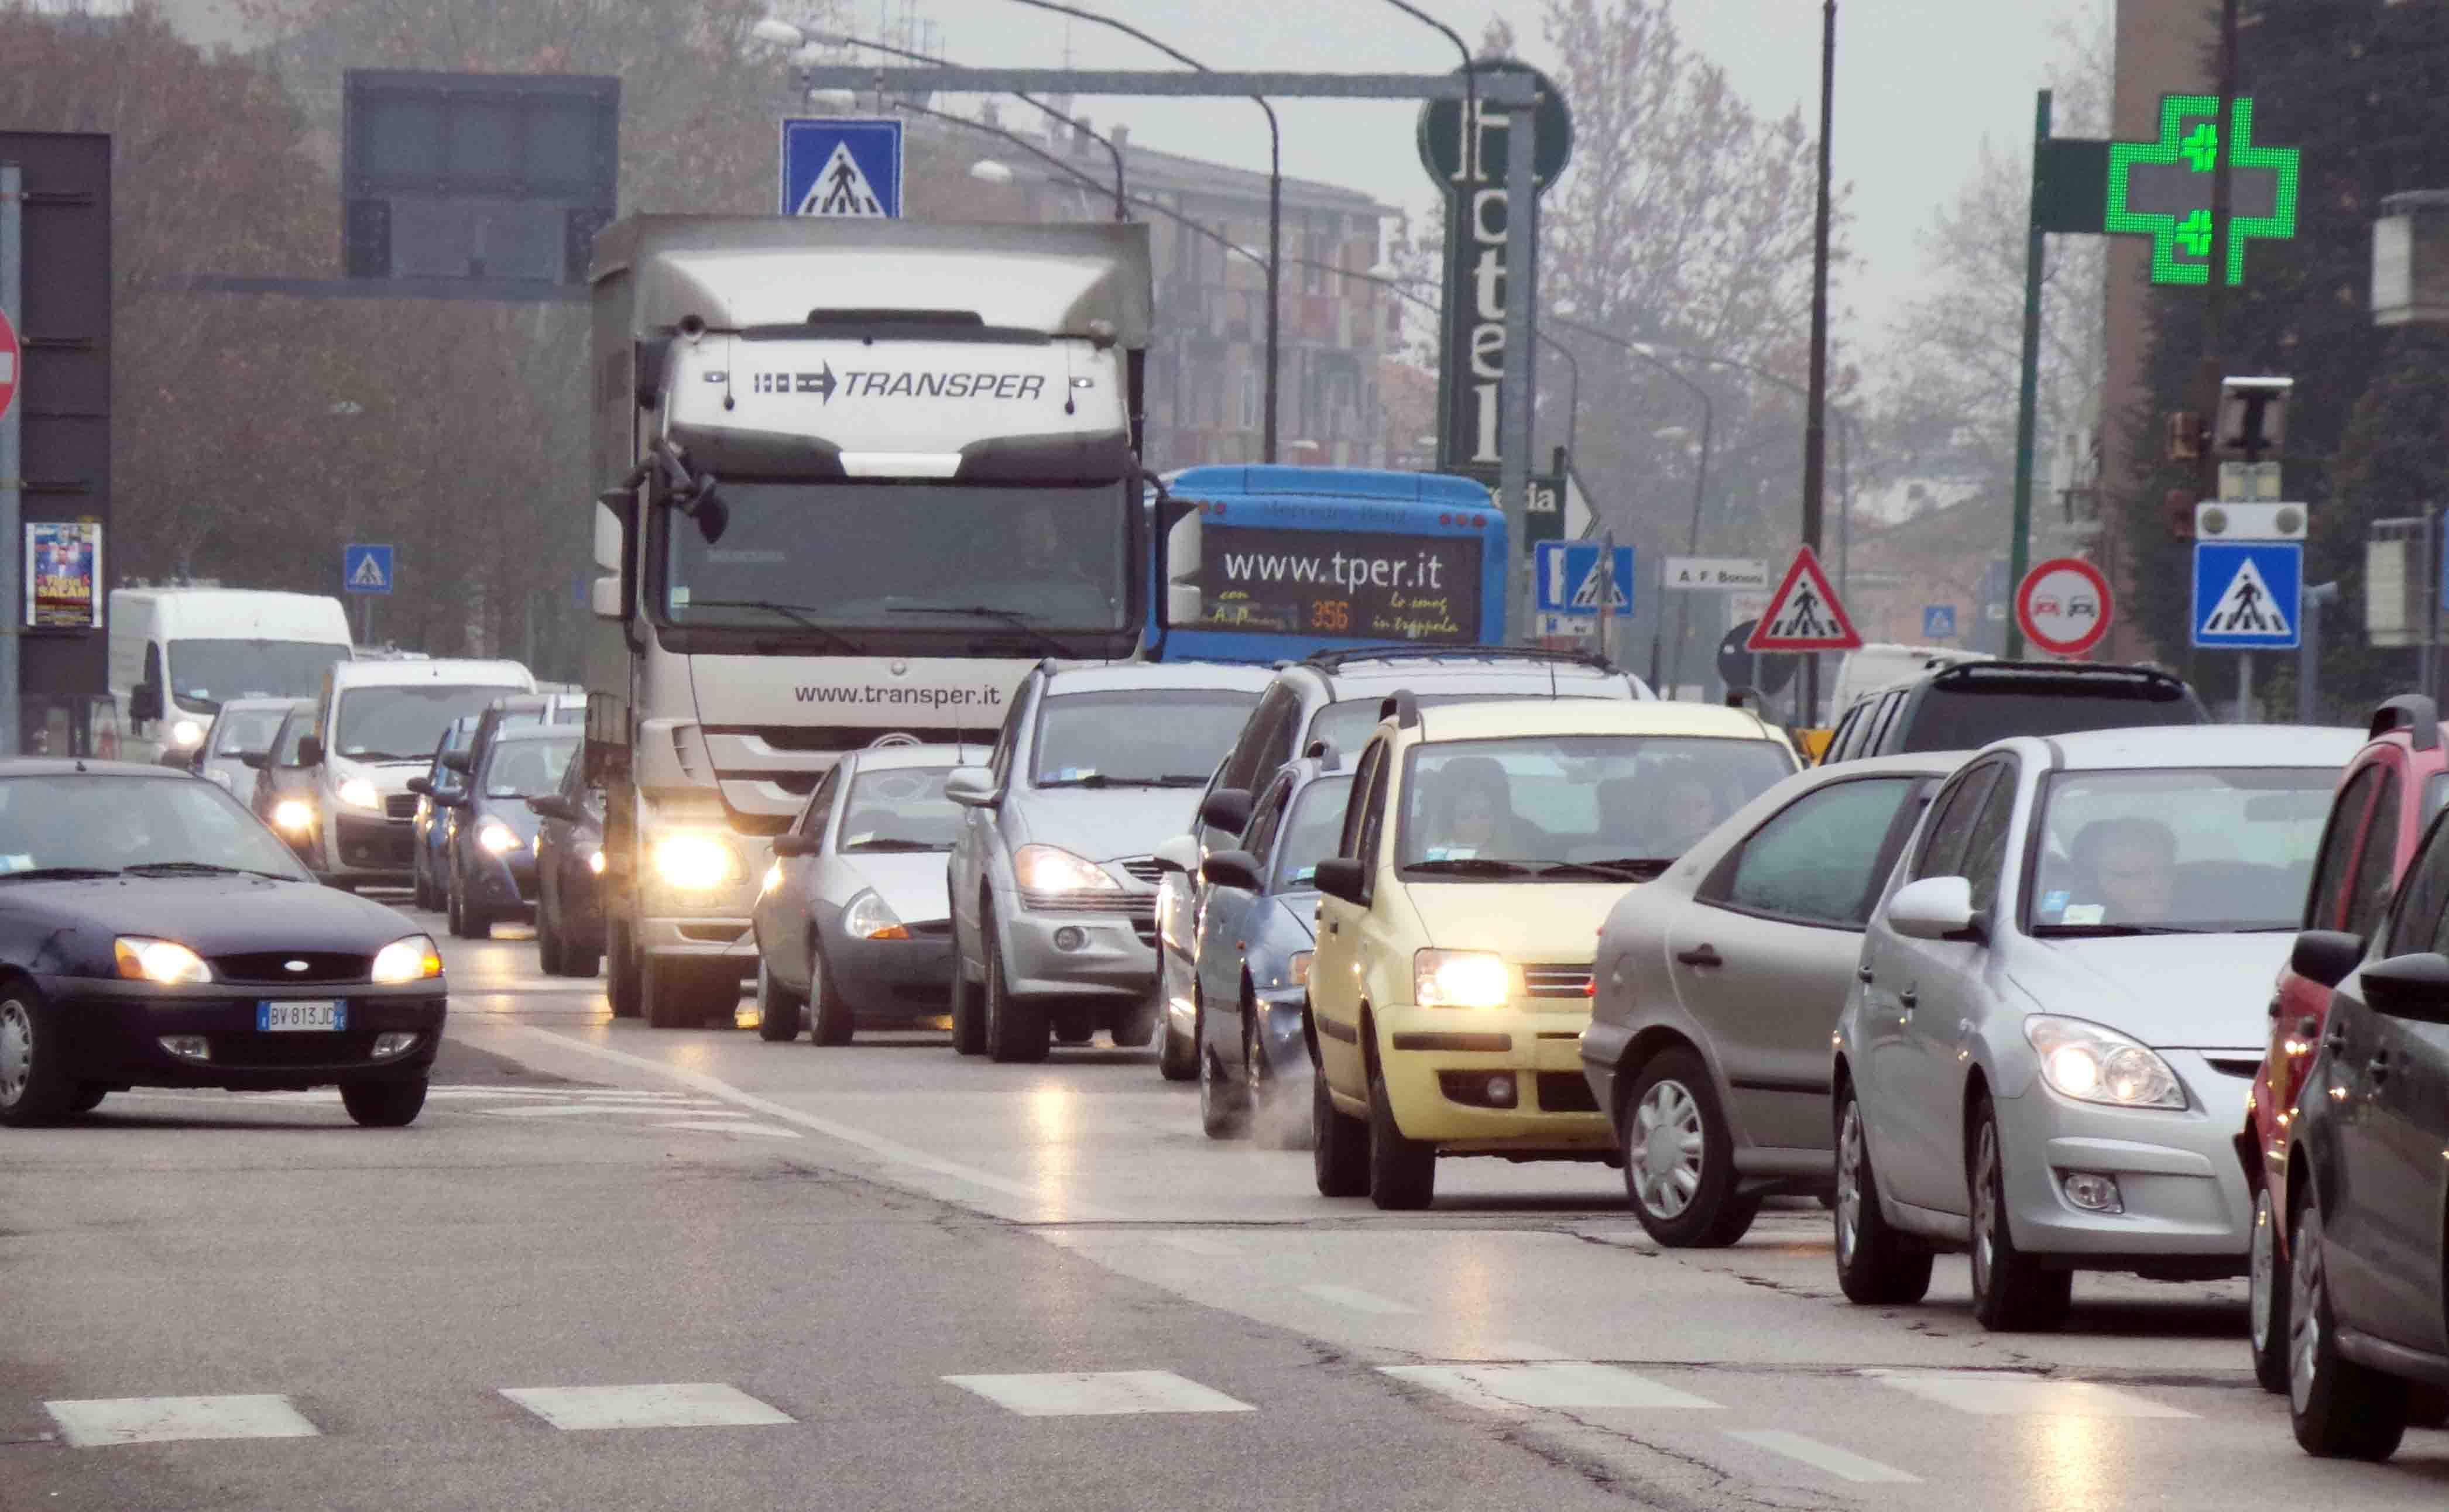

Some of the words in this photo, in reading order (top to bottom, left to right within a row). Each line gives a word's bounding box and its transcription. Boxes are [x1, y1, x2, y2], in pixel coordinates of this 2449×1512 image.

[843, 372, 1045, 400] TRANSPER
[1224, 550, 1443, 595] www.tper.it
[795, 685, 1001, 709] www.transper.it
